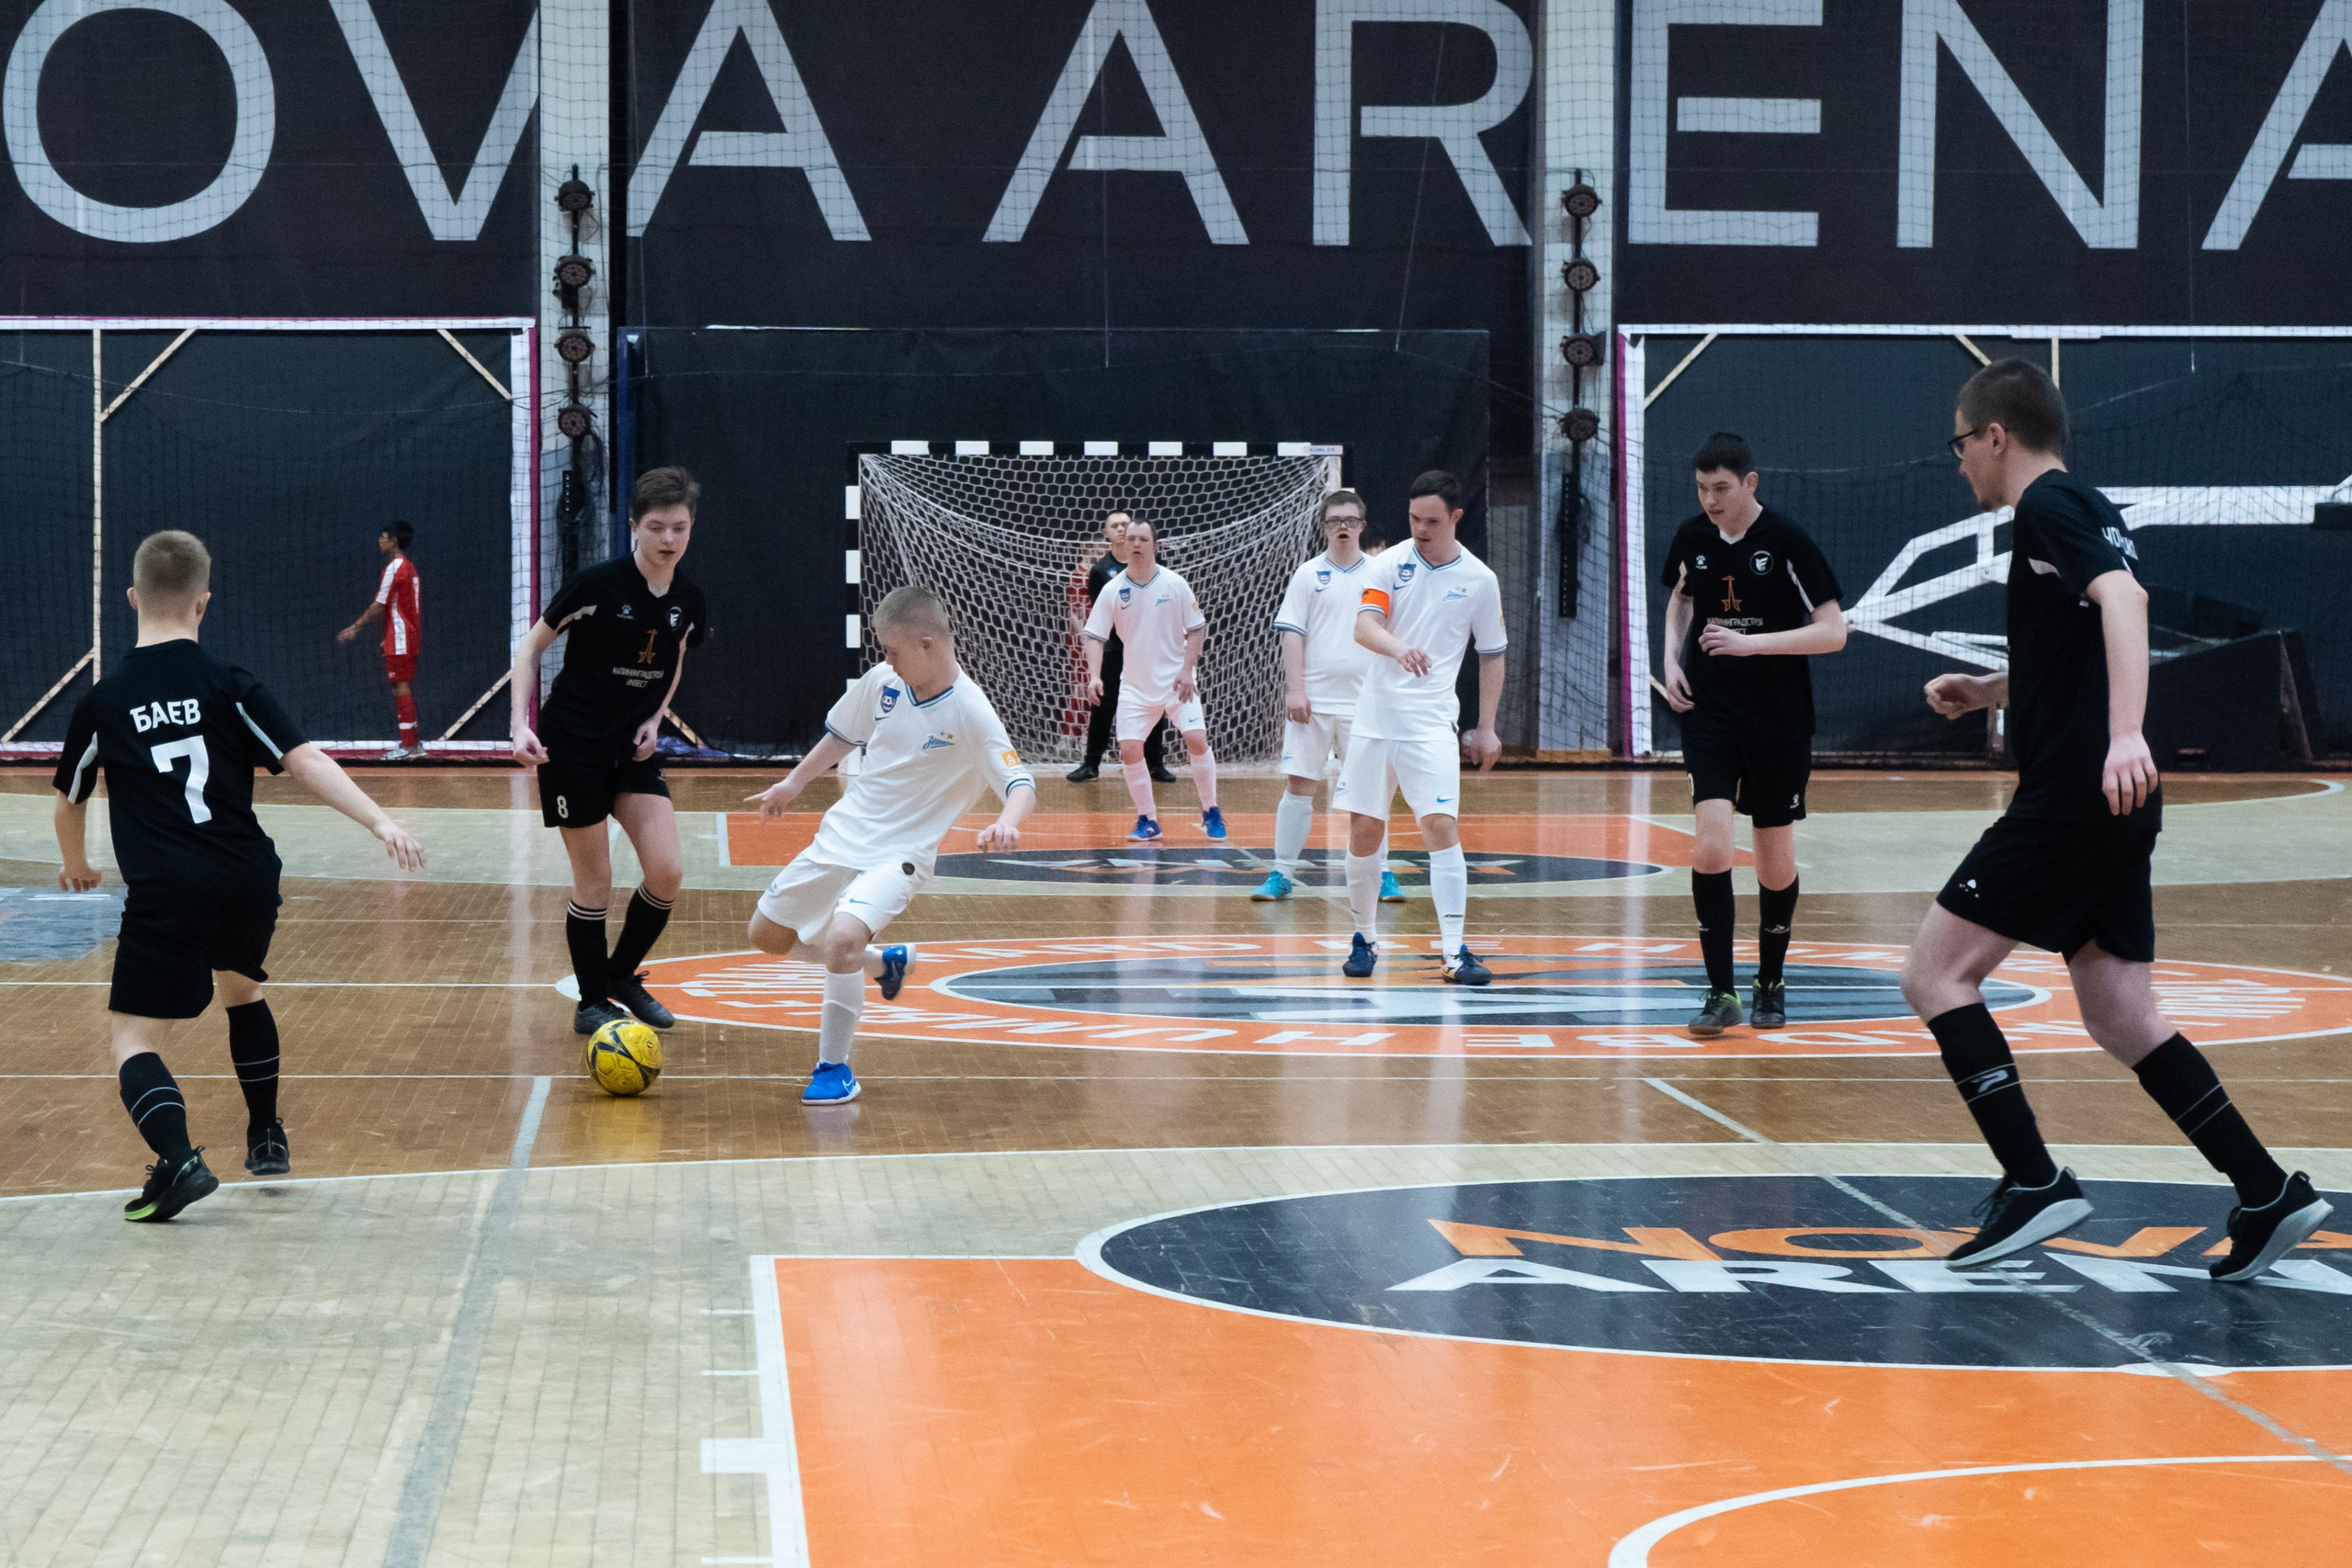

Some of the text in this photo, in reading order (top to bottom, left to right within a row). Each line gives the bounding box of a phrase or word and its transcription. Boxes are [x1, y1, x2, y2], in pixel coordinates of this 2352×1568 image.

[130, 698, 201, 733] БАЕВ
[151, 735, 212, 824] 7
[557, 795, 569, 819] 8
[1459, 1033, 1705, 1048] BE
